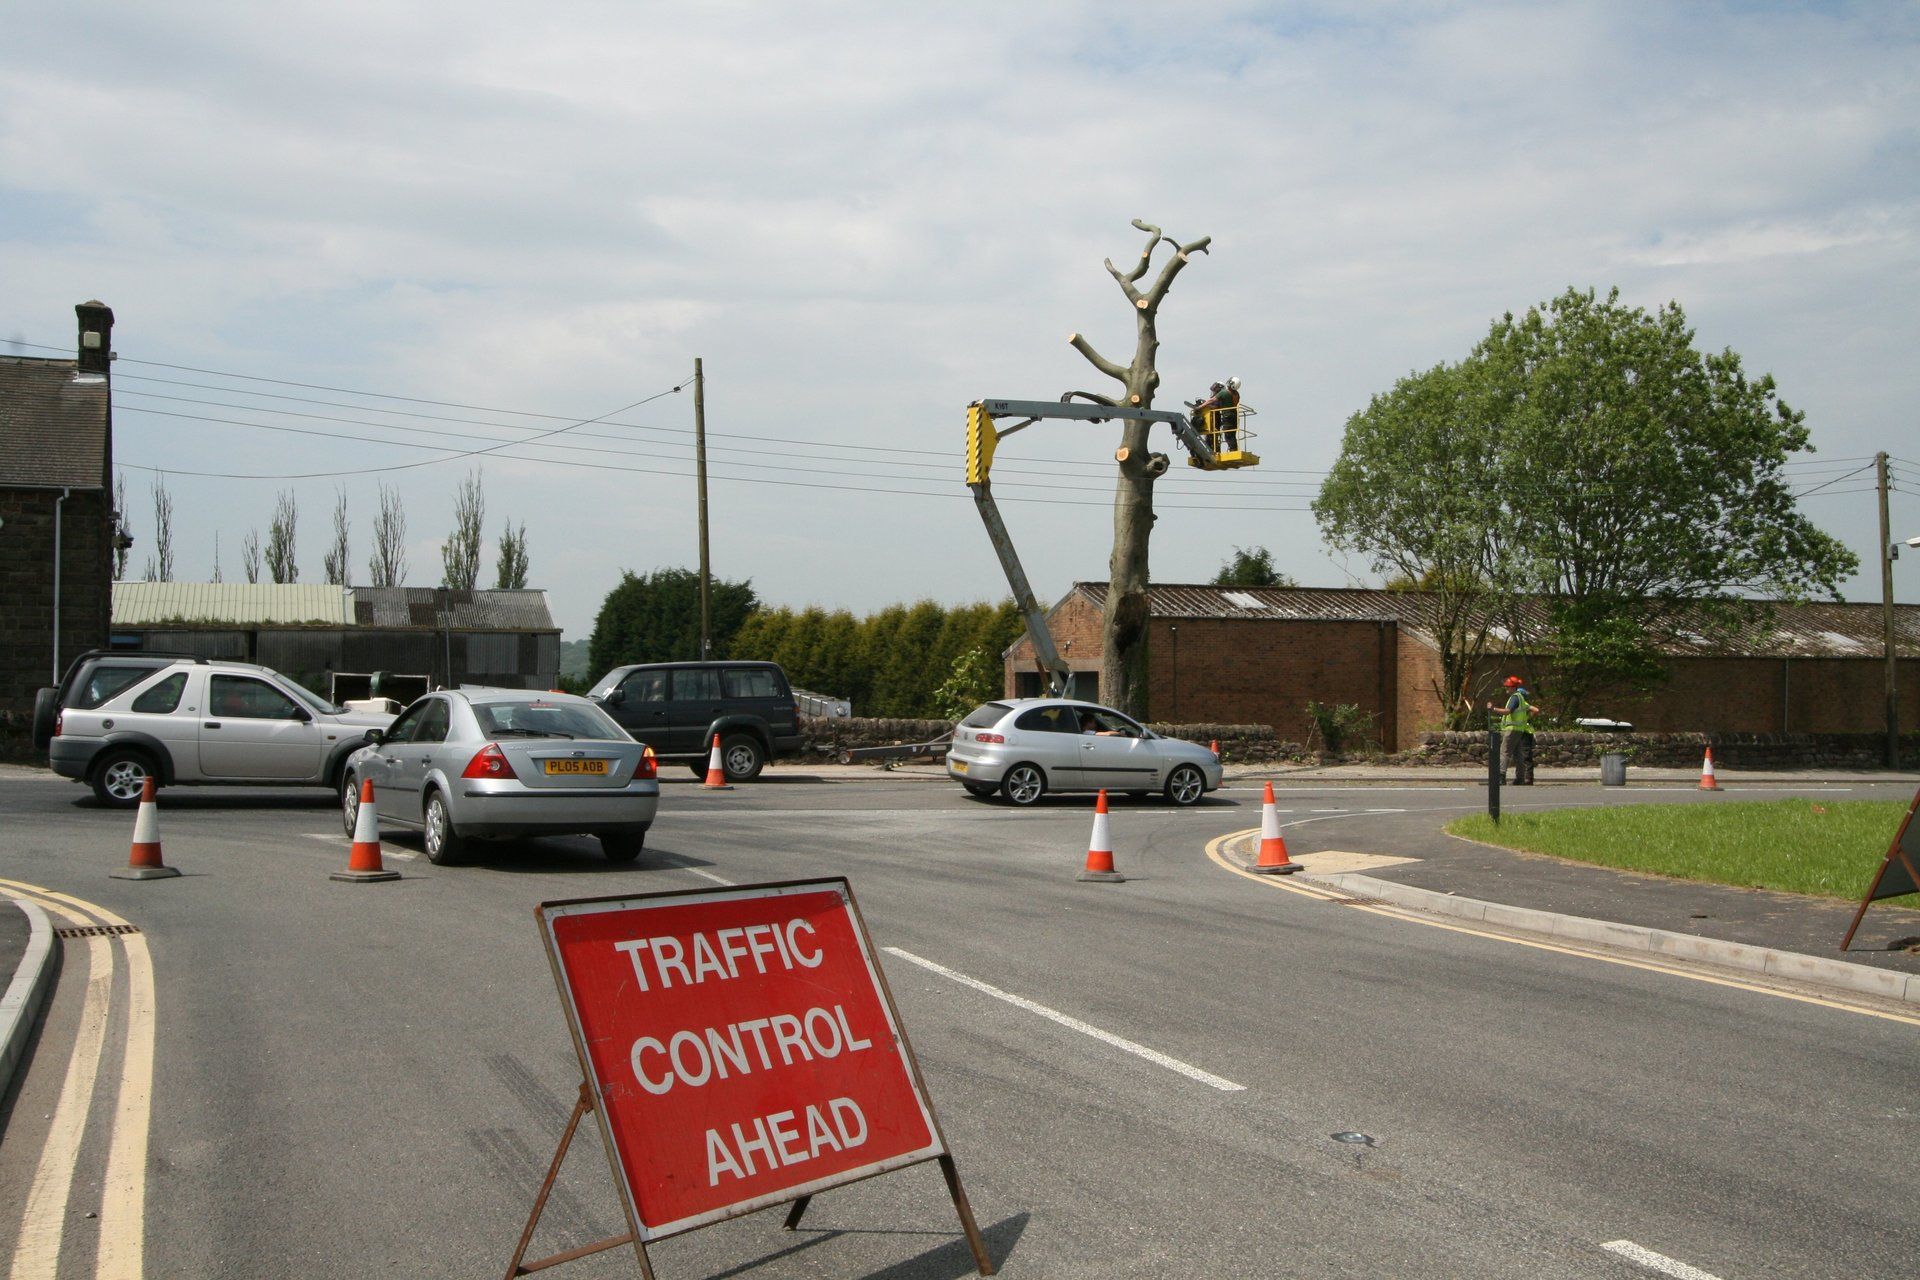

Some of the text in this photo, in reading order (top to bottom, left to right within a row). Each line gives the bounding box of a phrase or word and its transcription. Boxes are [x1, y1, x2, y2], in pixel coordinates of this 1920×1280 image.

[550, 761, 579, 772] PL05
[614, 918, 824, 992] TRAFFIC
[630, 1005, 872, 1096] CONTROL
[705, 1096, 869, 1187] AHEAD
